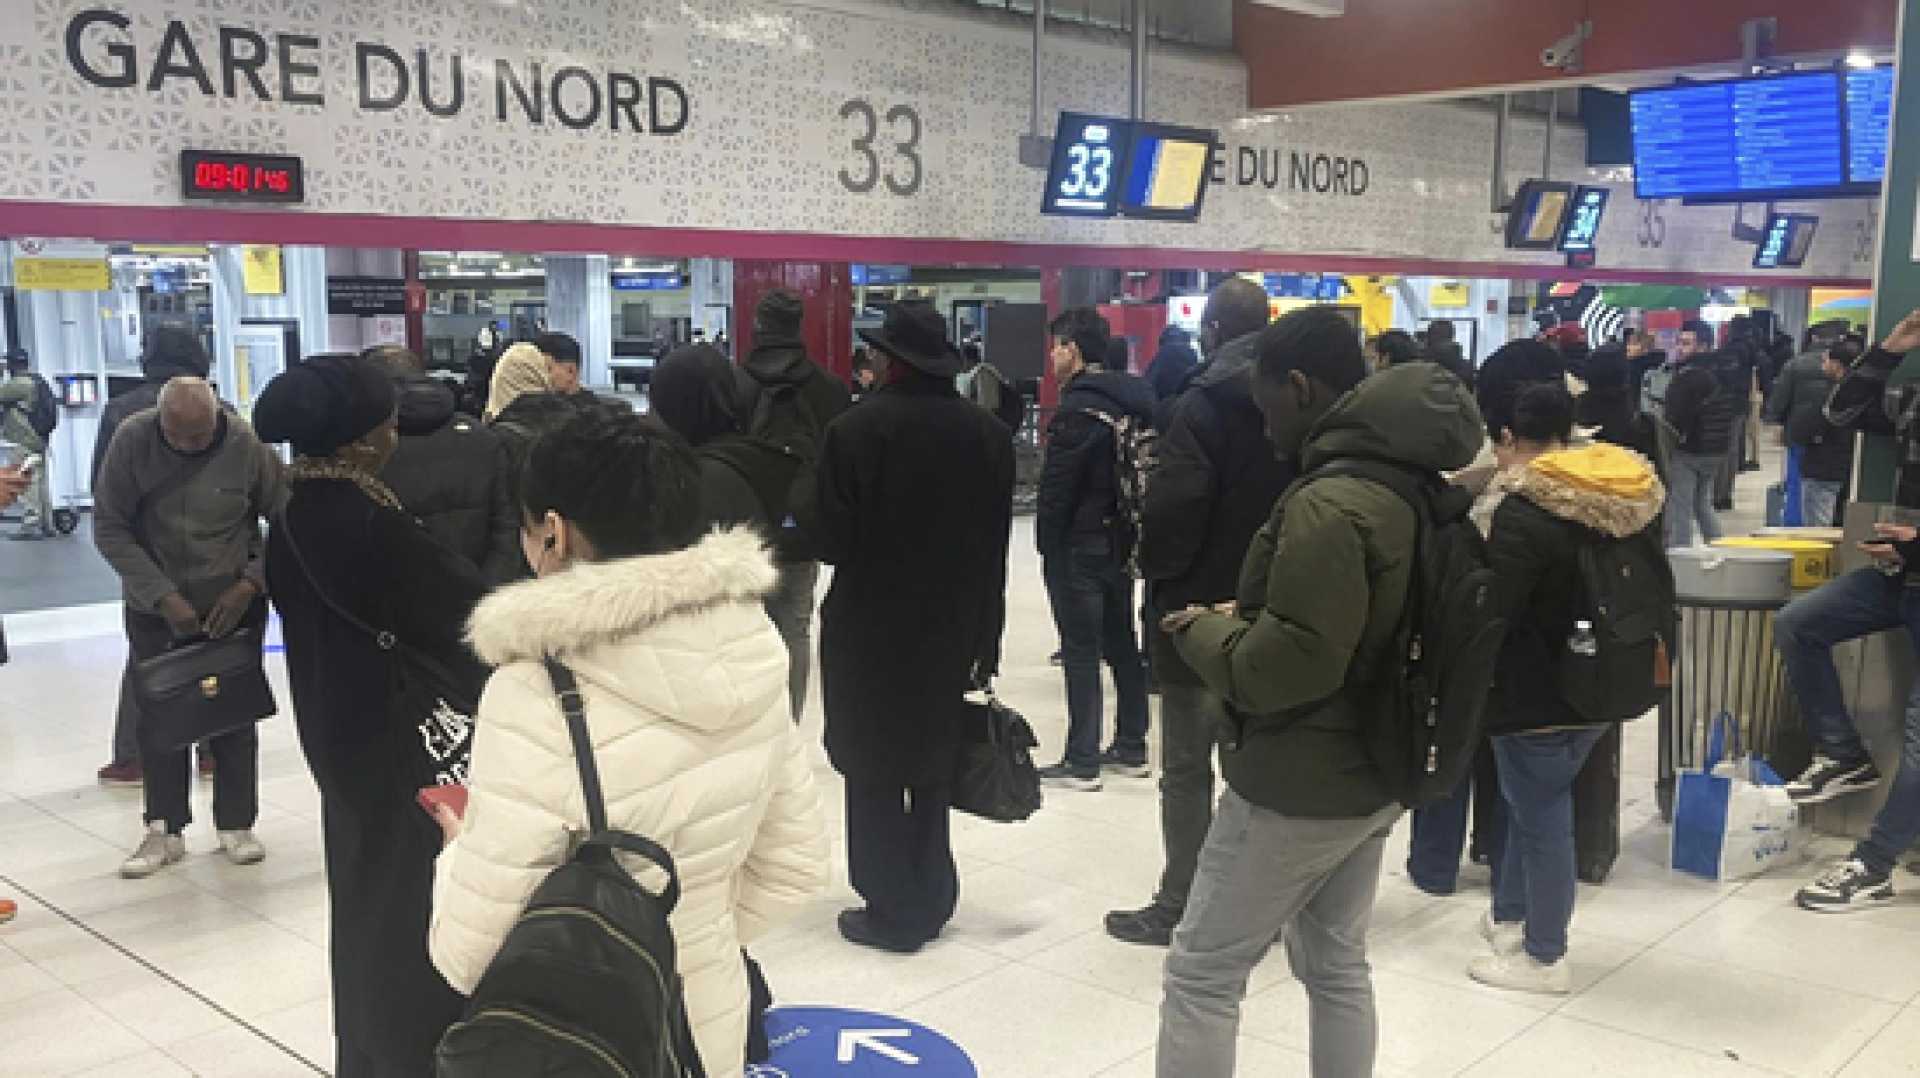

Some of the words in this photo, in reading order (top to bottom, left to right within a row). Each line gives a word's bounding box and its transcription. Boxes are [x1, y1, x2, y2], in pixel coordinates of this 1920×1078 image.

[65, 9, 325, 106] GARE
[355, 41, 464, 117] DU
[496, 58, 689, 136] NORD
[837, 98, 922, 197] 33
[1060, 142, 1112, 197] 33
[1238, 146, 1279, 189] DU
[1288, 152, 1369, 196] NORD
